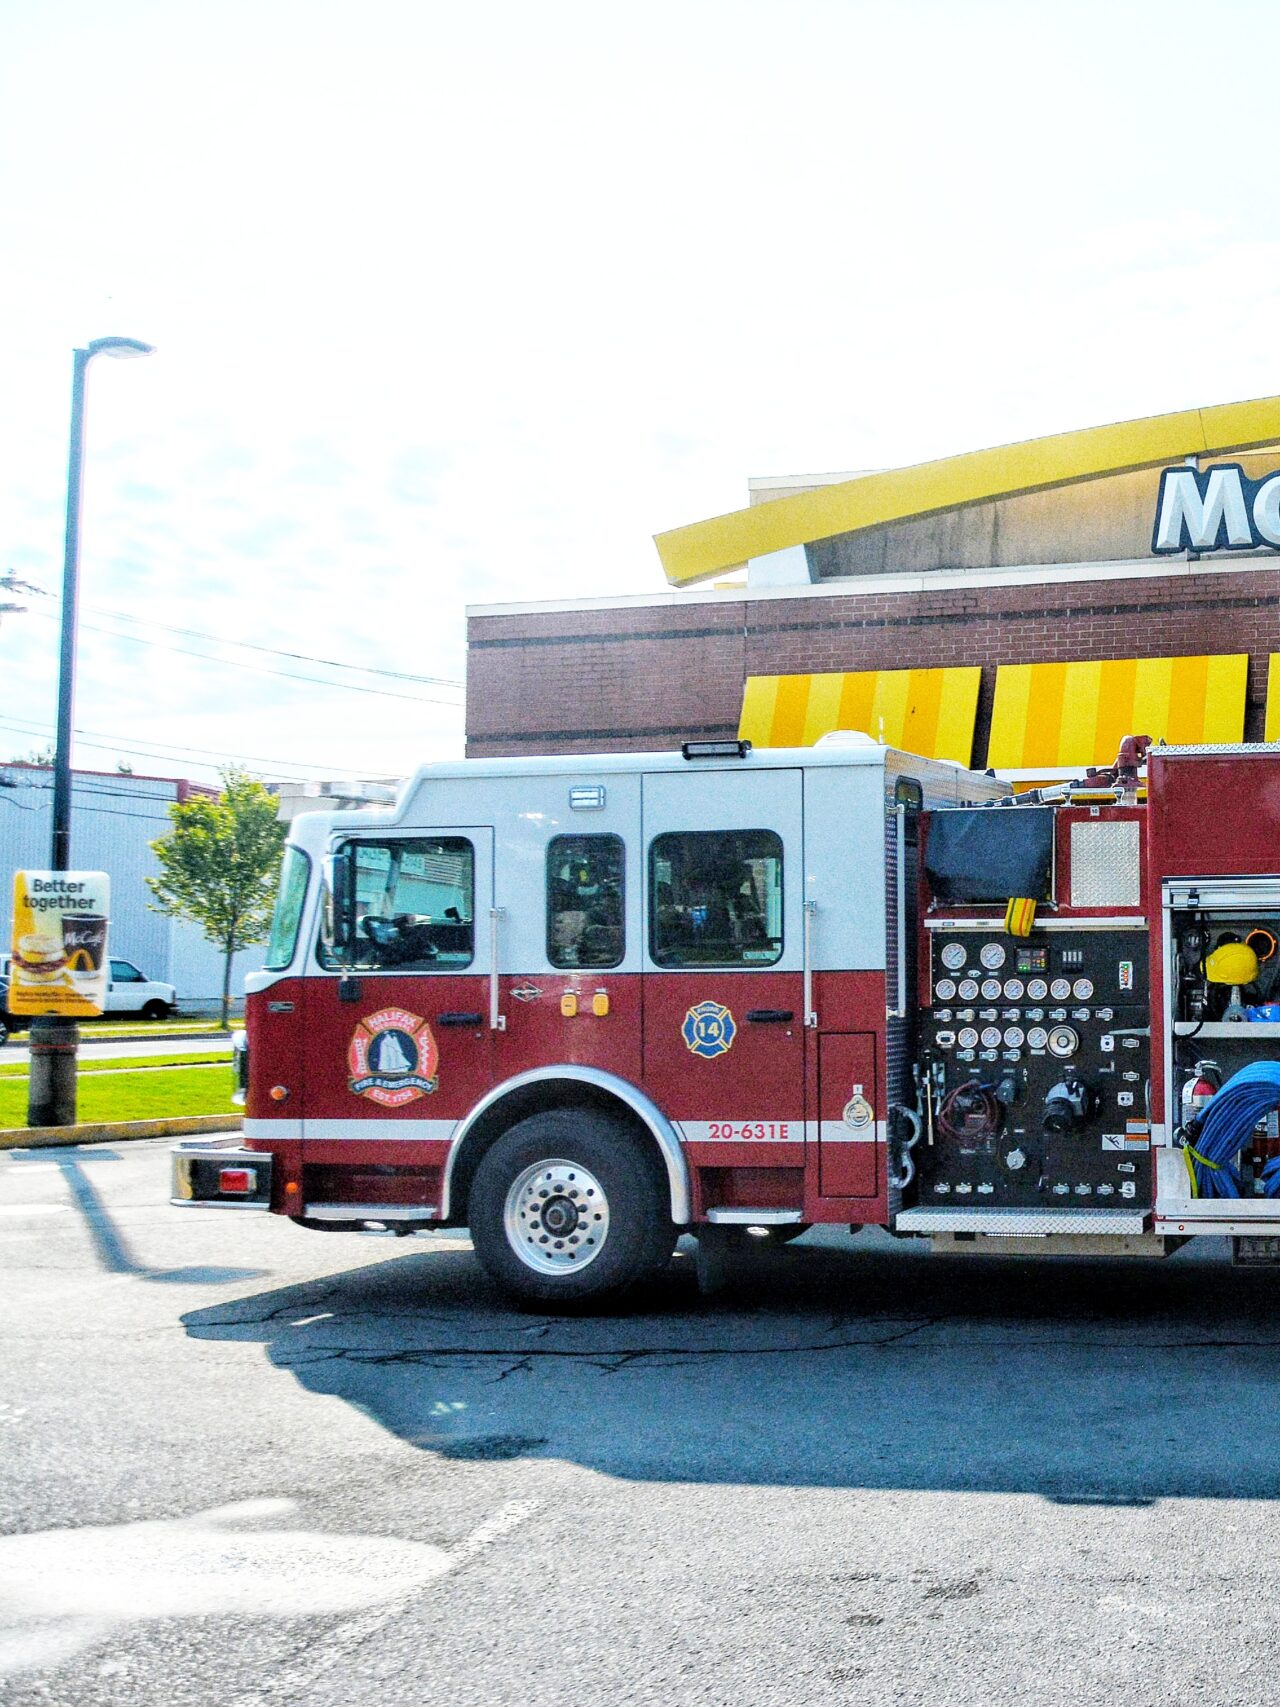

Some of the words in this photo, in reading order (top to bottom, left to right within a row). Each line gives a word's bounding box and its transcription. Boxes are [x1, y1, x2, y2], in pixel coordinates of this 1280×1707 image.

[33, 879, 85, 893] Better
[23, 895, 97, 912] together
[368, 1011, 417, 1026] HALIFAX
[698, 1022, 720, 1037] 14
[354, 1077, 374, 1091] FIRE
[382, 1077, 434, 1090] EMERGENCY
[709, 1123, 789, 1139] 20-631E
